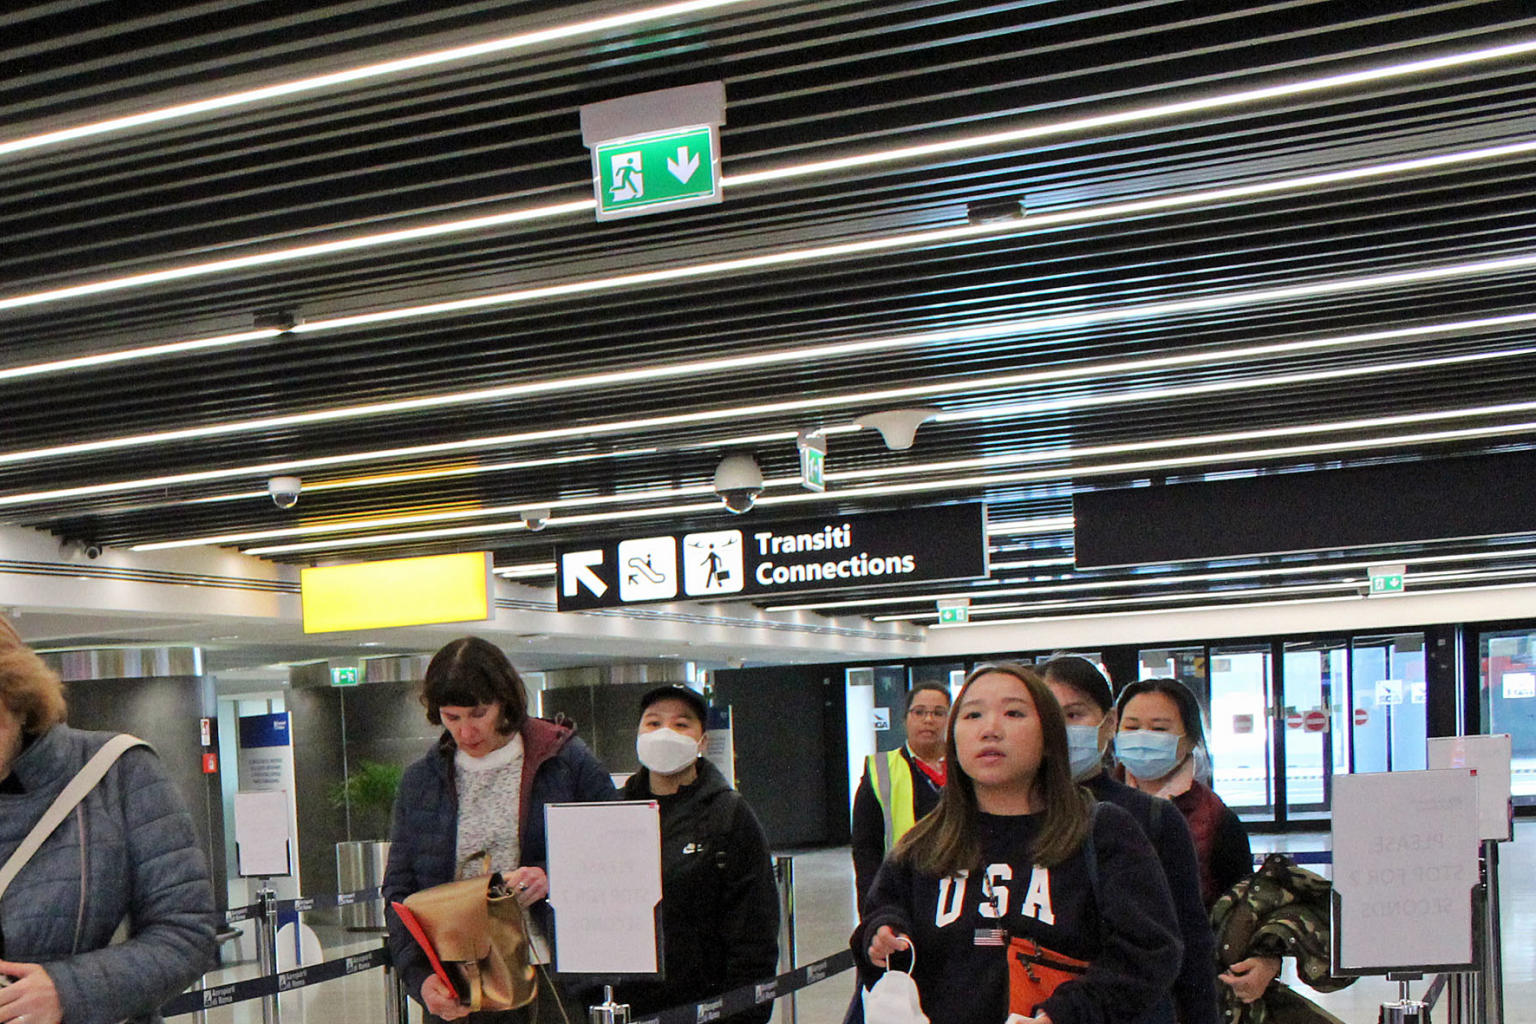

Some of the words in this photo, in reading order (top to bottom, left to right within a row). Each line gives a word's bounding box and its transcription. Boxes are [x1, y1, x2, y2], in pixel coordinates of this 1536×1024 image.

[754, 523, 852, 555] Transiti
[756, 552, 916, 585] Connections
[935, 863, 1056, 928] USA
